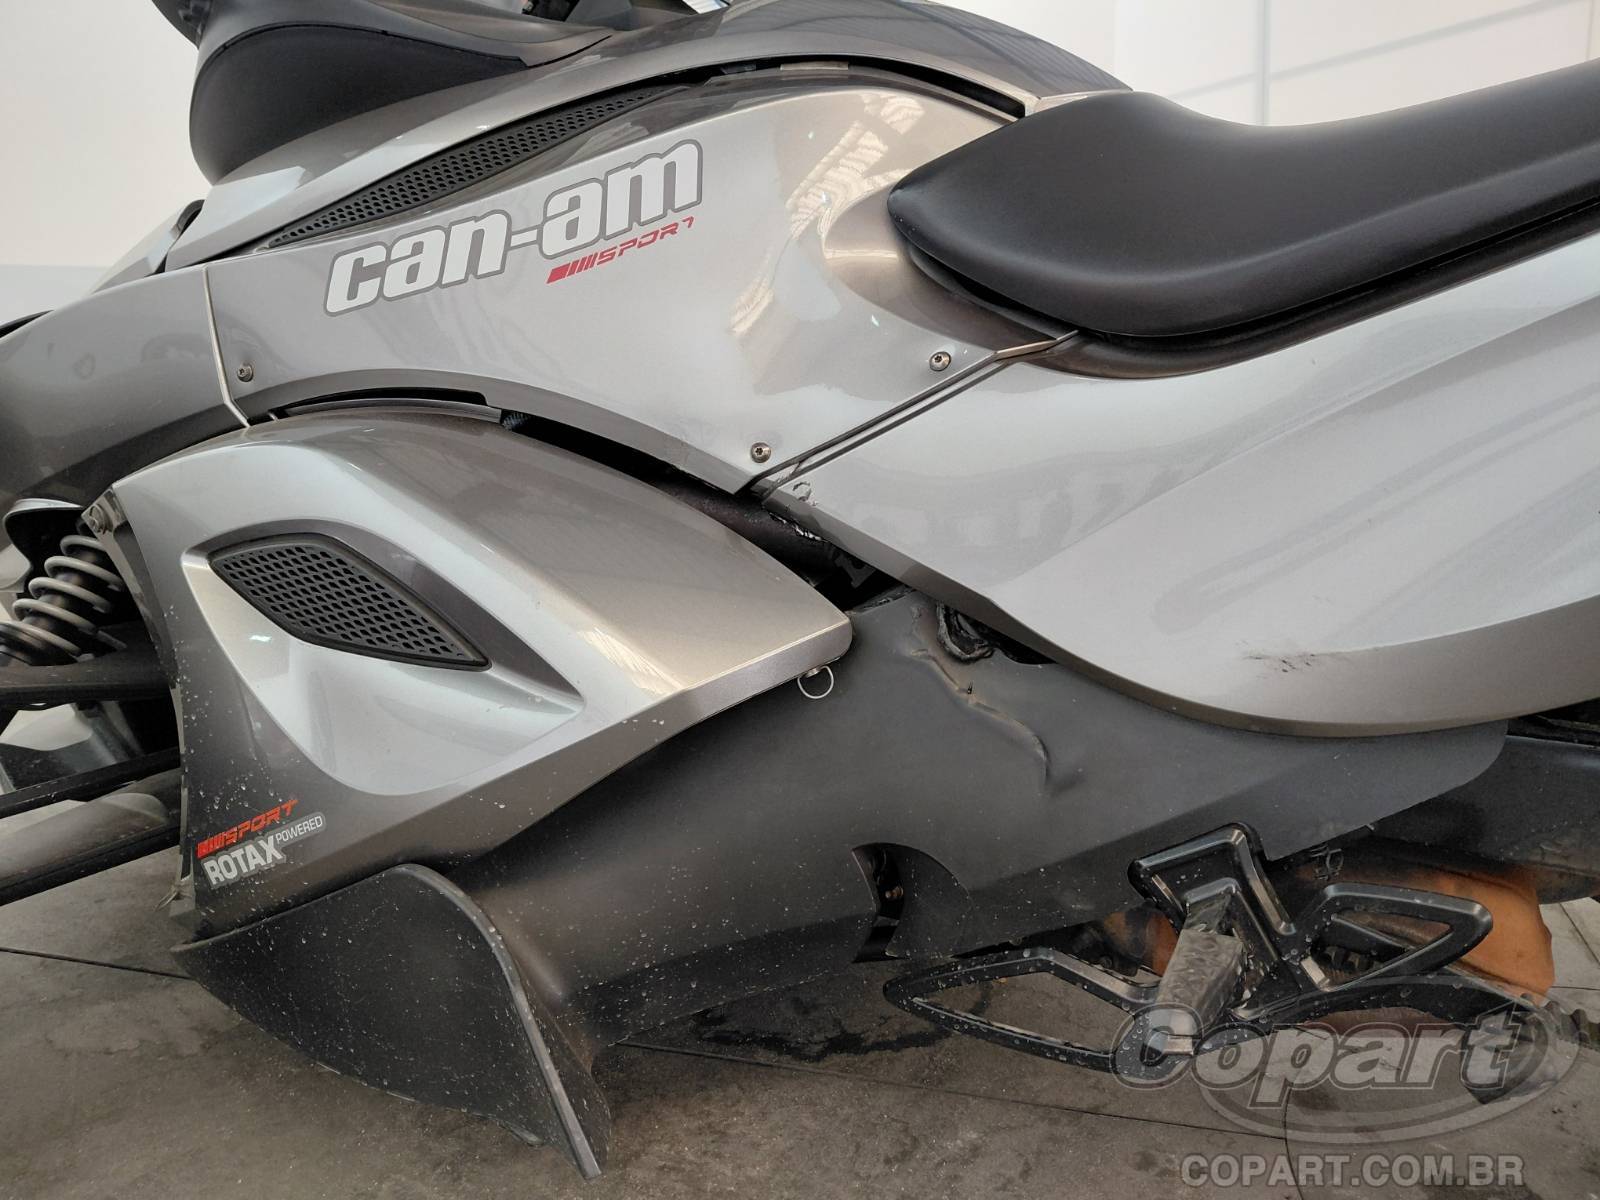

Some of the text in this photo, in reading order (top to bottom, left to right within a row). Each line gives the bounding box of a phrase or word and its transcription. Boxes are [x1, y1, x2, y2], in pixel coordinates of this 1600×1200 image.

[324, 139, 703, 317] can-am
[203, 815, 323, 885] ROTAX POWERED
[224, 799, 299, 845] SPORT
